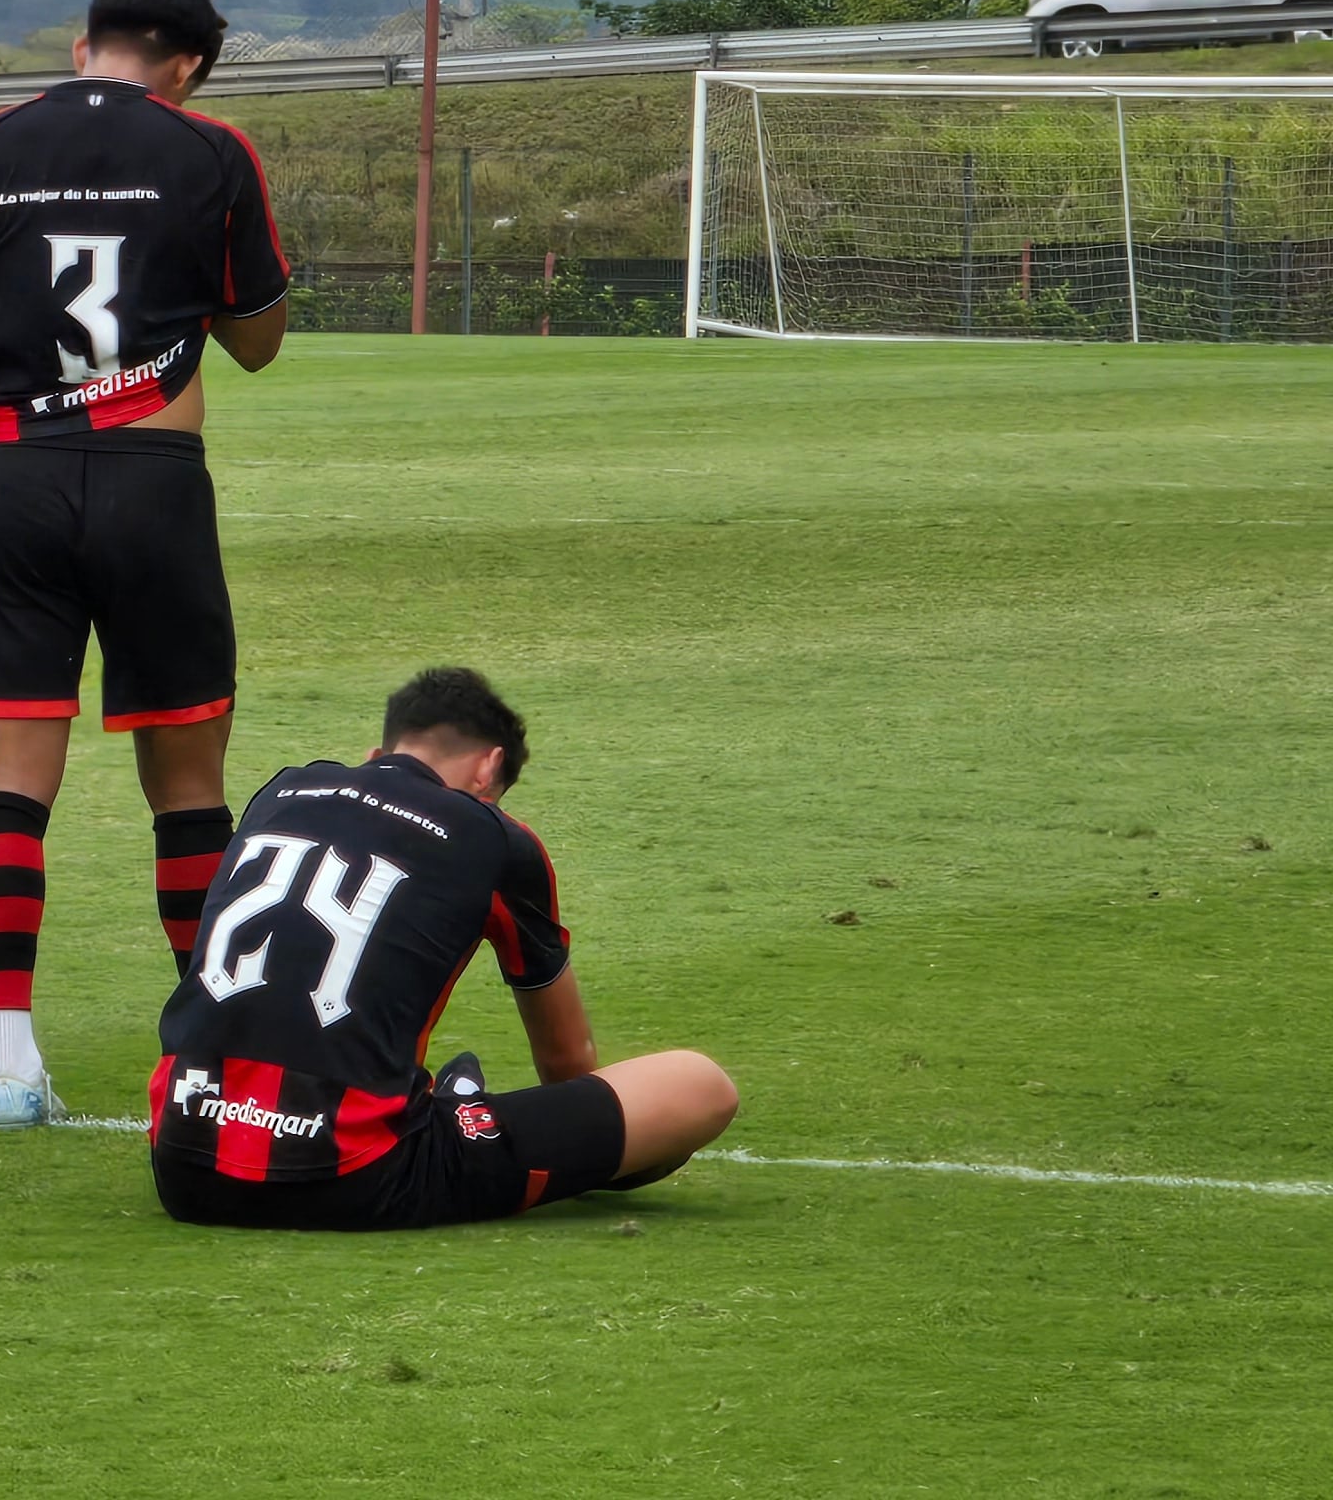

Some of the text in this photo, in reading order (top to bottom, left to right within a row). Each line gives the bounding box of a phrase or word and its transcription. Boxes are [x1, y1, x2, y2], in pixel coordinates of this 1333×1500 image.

[42, 234, 127, 384] 3
[198, 826, 410, 1028] 24
[199, 1097, 324, 1140] medismart
